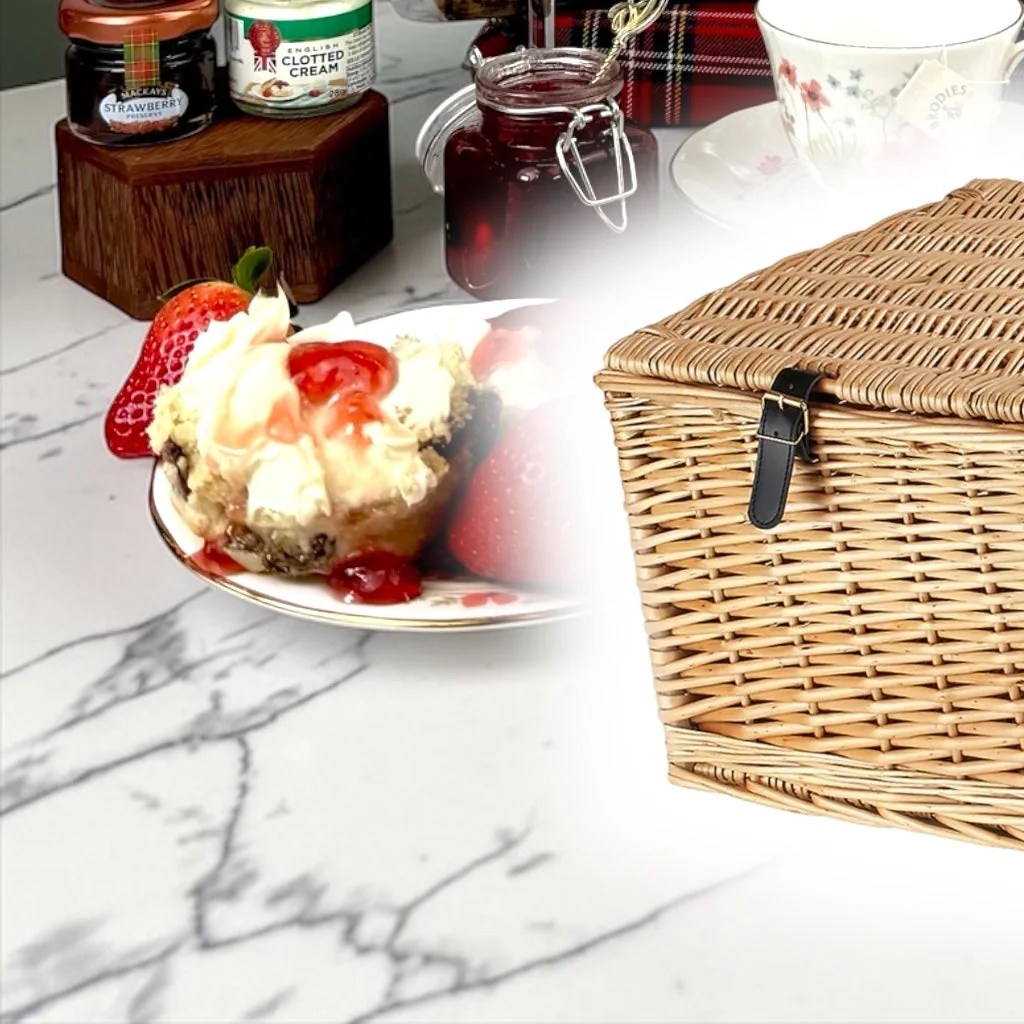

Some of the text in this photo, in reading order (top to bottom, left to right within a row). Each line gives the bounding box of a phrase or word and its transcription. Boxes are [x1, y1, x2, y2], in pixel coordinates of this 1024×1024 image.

[287, 43, 339, 54] ENGLISH
[281, 50, 345, 66] CLOTTED
[289, 63, 339, 77] CREAM
[121, 86, 168, 98] MACKAYS
[104, 98, 183, 113] STRAWBERRY
